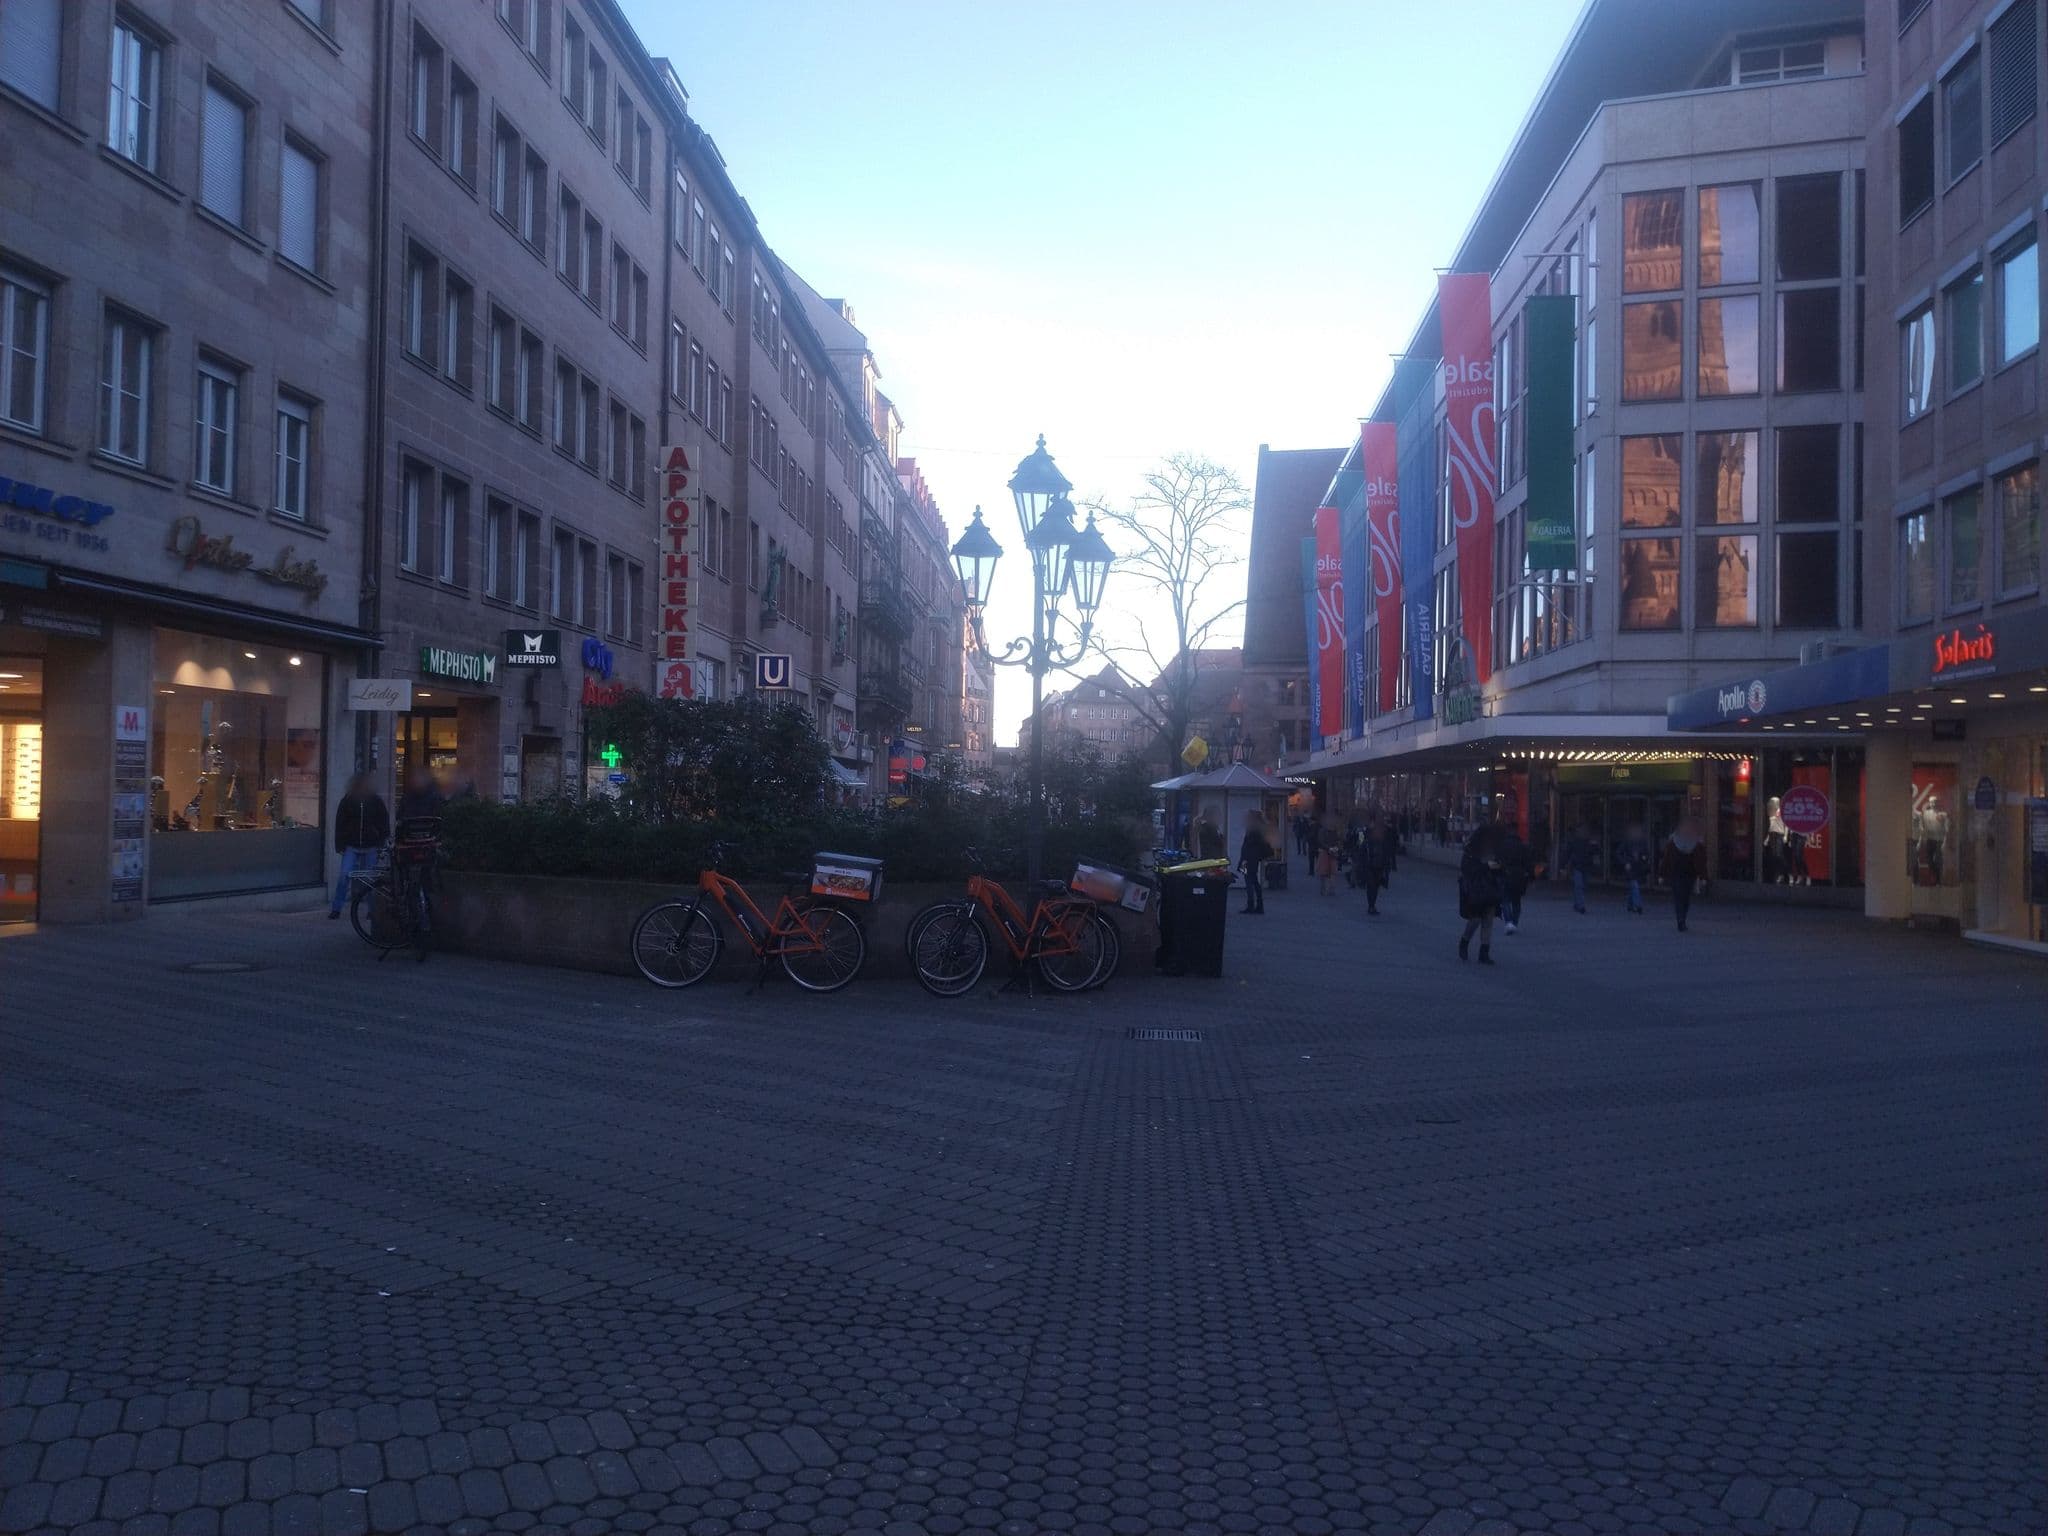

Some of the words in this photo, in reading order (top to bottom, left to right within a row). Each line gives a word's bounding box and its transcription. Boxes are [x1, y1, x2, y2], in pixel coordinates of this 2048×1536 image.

[665, 447, 690, 659] APOTHEKE
[508, 654, 557, 665] MEPHISTO
[1932, 624, 1993, 673] Solaris
[430, 647, 481, 682] MEPHISTO
[764, 659, 784, 684] U
[354, 683, 400, 705] Leidig
[1717, 685, 1745, 718] Apollo
[124, 711, 139, 732] M
